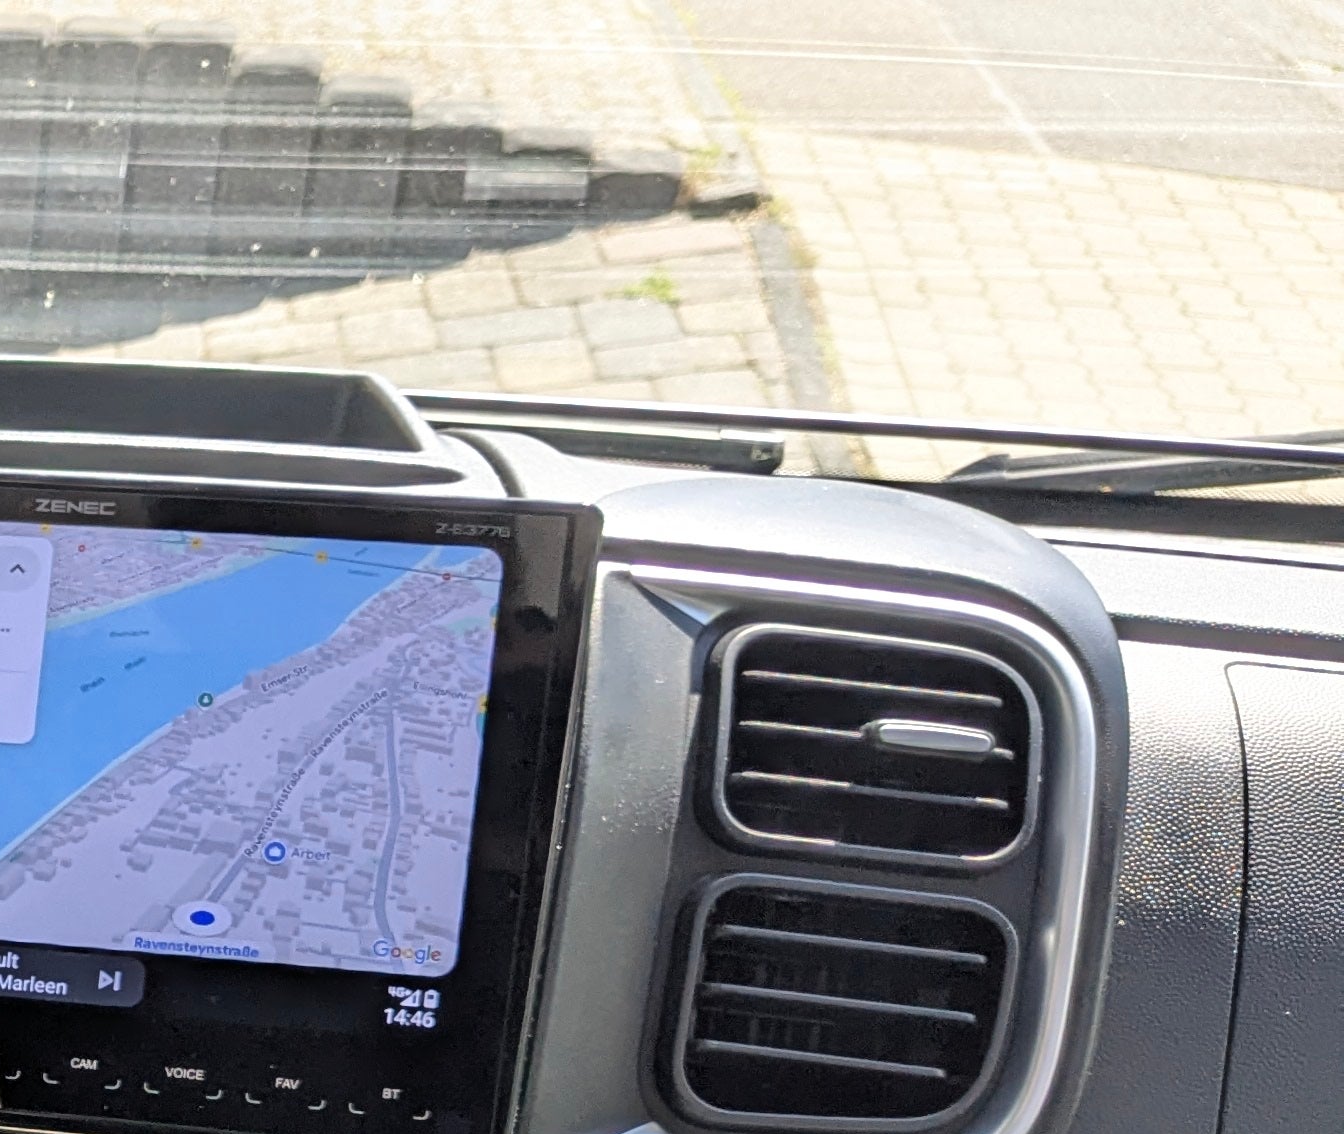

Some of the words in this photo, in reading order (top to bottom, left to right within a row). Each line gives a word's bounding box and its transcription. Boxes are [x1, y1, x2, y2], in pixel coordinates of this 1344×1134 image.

[35, 498, 116, 515] ZENEC
[134, 936, 259, 959] Ravensteynstraße
[373, 940, 442, 964] Google
[384, 1007, 437, 1028] 14:46
[70, 1057, 98, 1071] CAM
[165, 1066, 205, 1081] VOICE
[275, 1077, 301, 1090] FAV
[382, 1088, 401, 1100] BT
